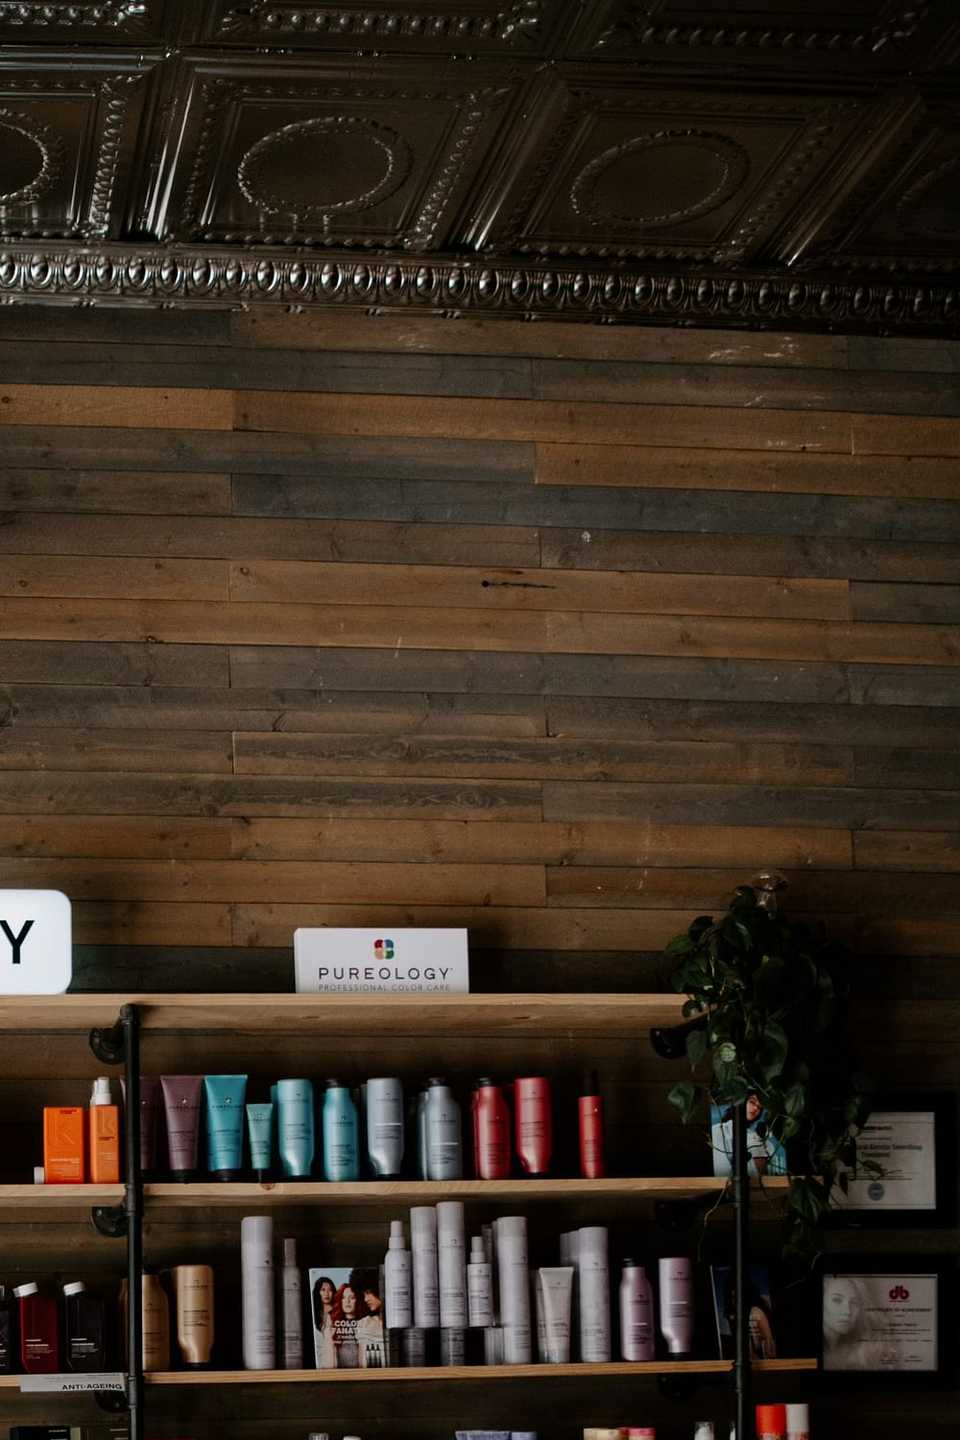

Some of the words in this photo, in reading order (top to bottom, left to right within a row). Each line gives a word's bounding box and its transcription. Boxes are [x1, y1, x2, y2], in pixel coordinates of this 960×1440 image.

[318, 967, 450, 980] PUREOLOGY
[318, 984, 387, 992] PROFESSIONAL
[391, 984, 423, 992] COLOR
[427, 984, 450, 992] CARE
[62, 1383, 123, 1391] ANTI-AGEING
